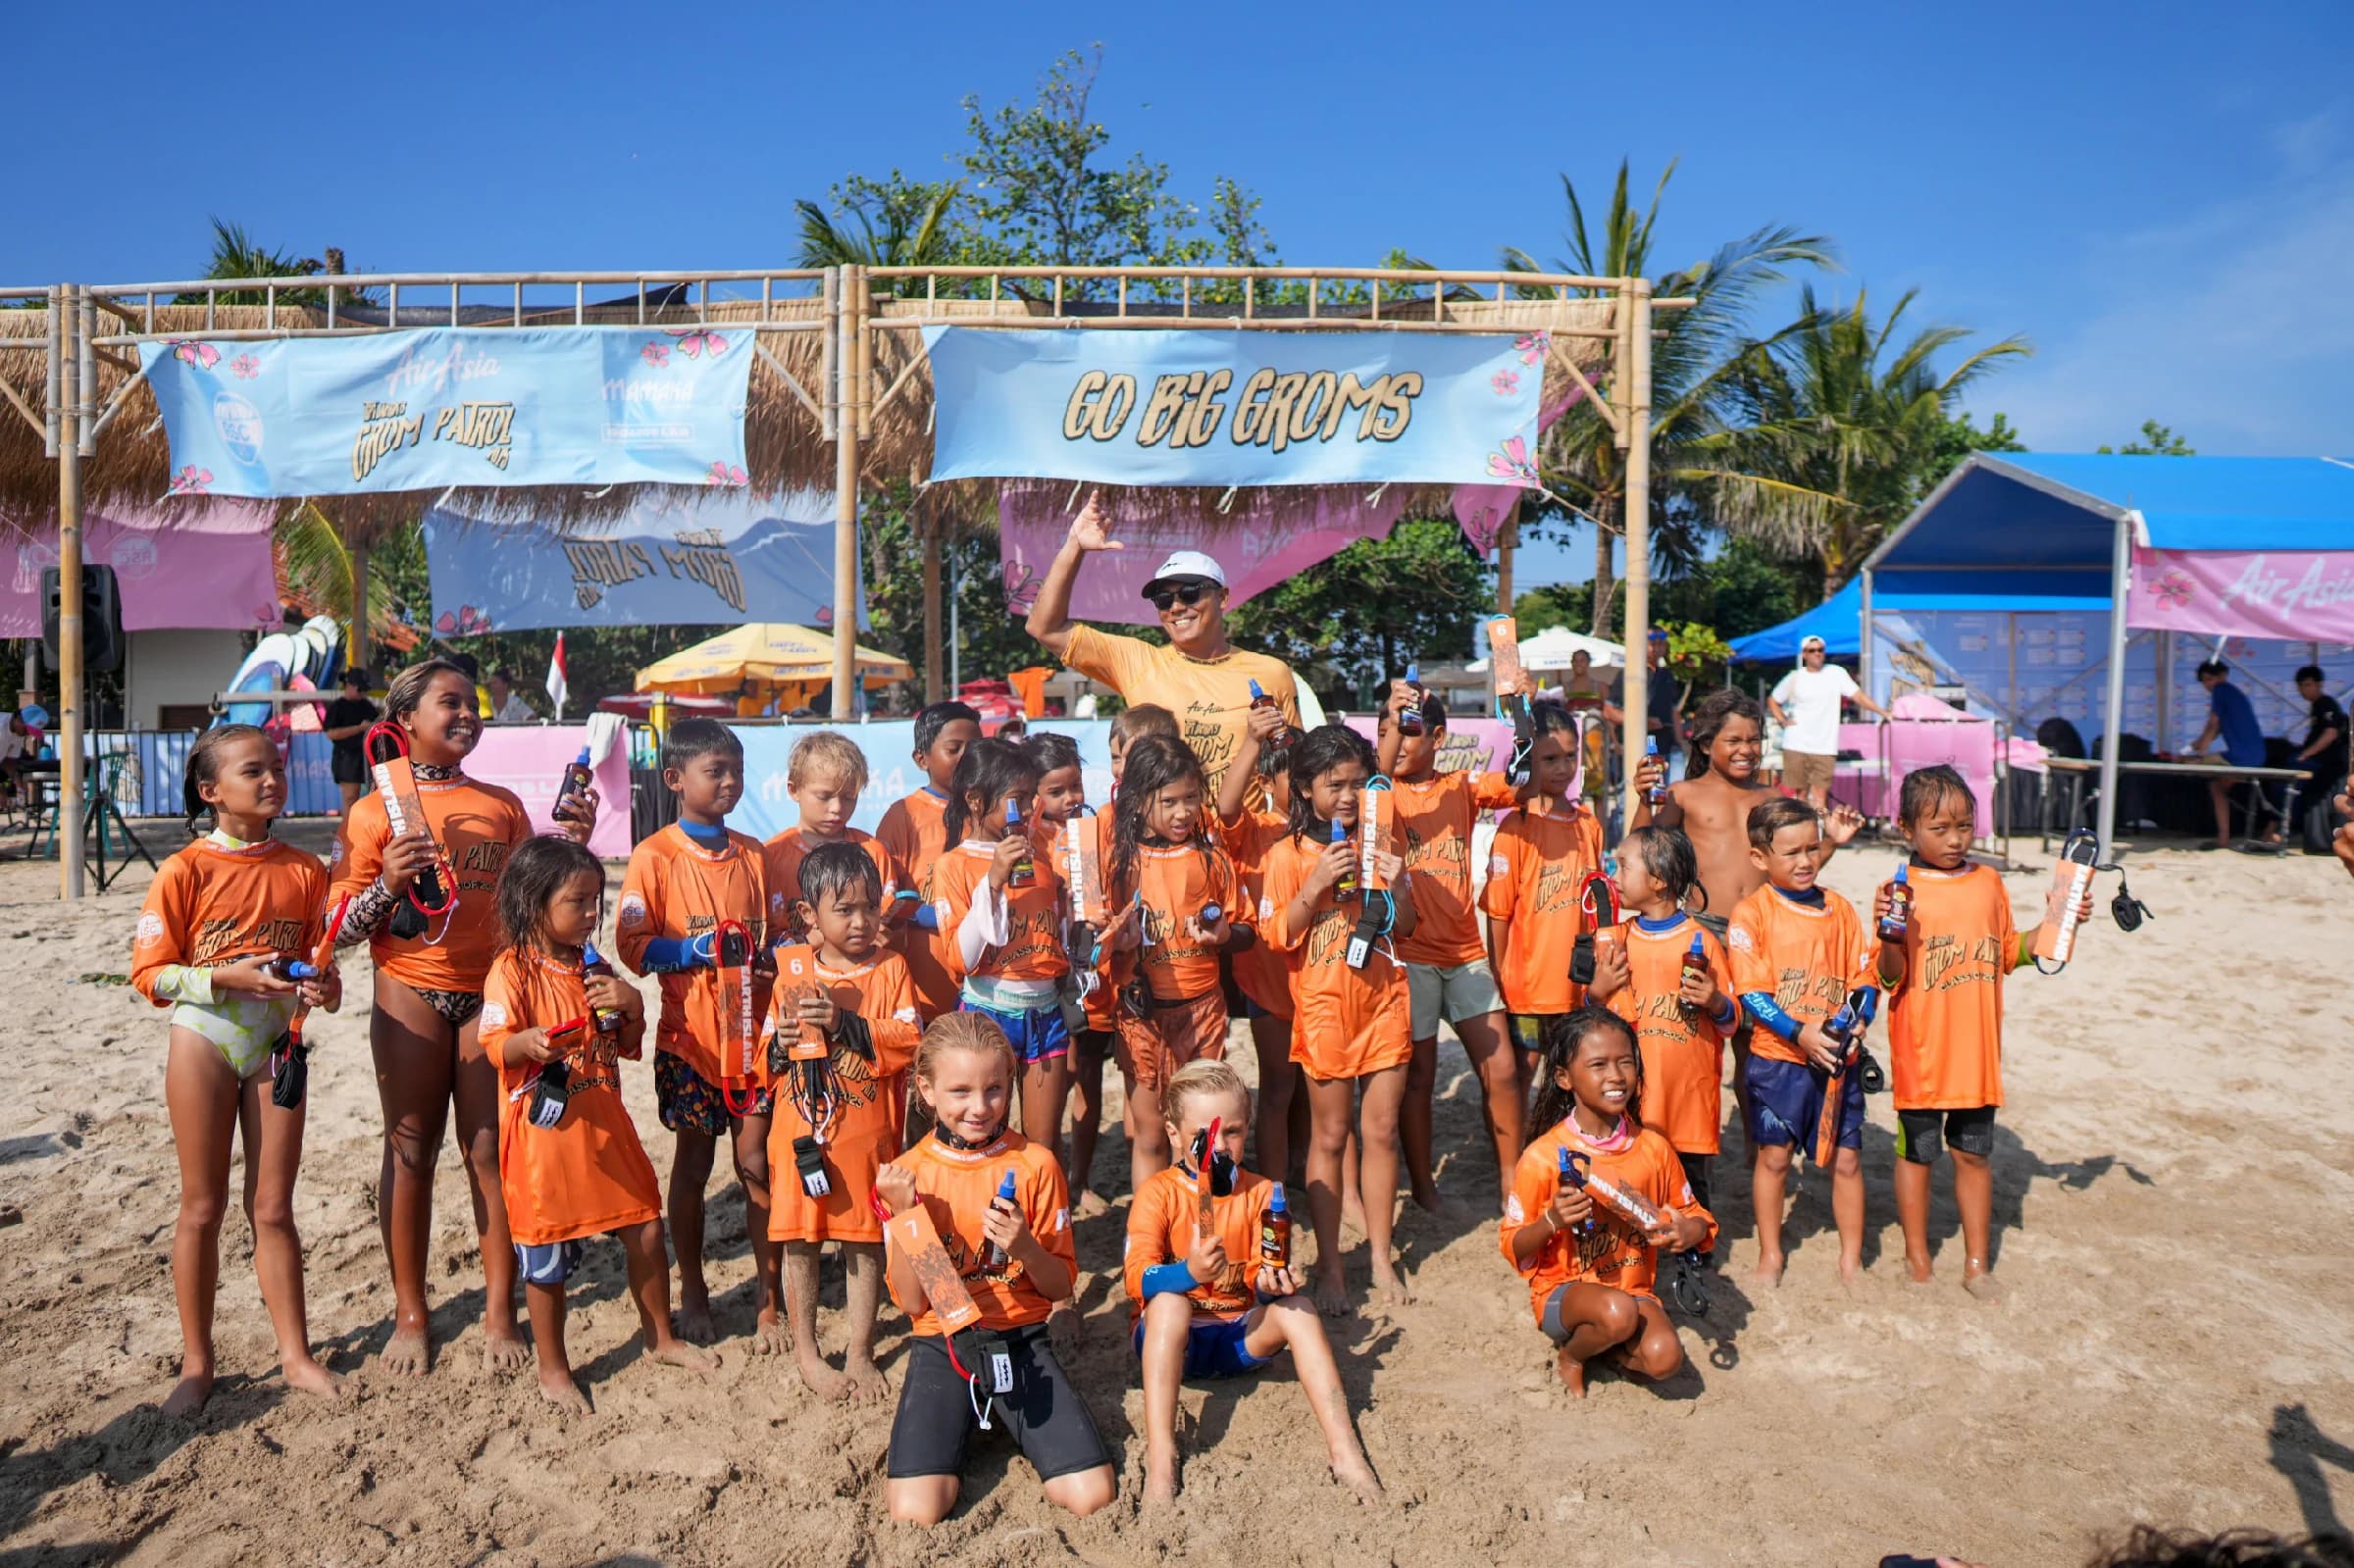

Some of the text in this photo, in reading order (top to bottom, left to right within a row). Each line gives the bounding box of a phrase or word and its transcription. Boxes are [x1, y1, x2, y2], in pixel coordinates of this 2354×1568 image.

[433, 341, 501, 392] Asia
[352, 413, 425, 482] GROM
[433, 401, 516, 449] PATROL
[1064, 370, 1136, 440] GO
[1231, 368, 1423, 454] GROMS
[2220, 553, 2354, 621] Air Asi
[1496, 625, 1508, 636] 6
[790, 958, 804, 975] 6
[741, 965, 753, 1075] EARTH ISLAND
